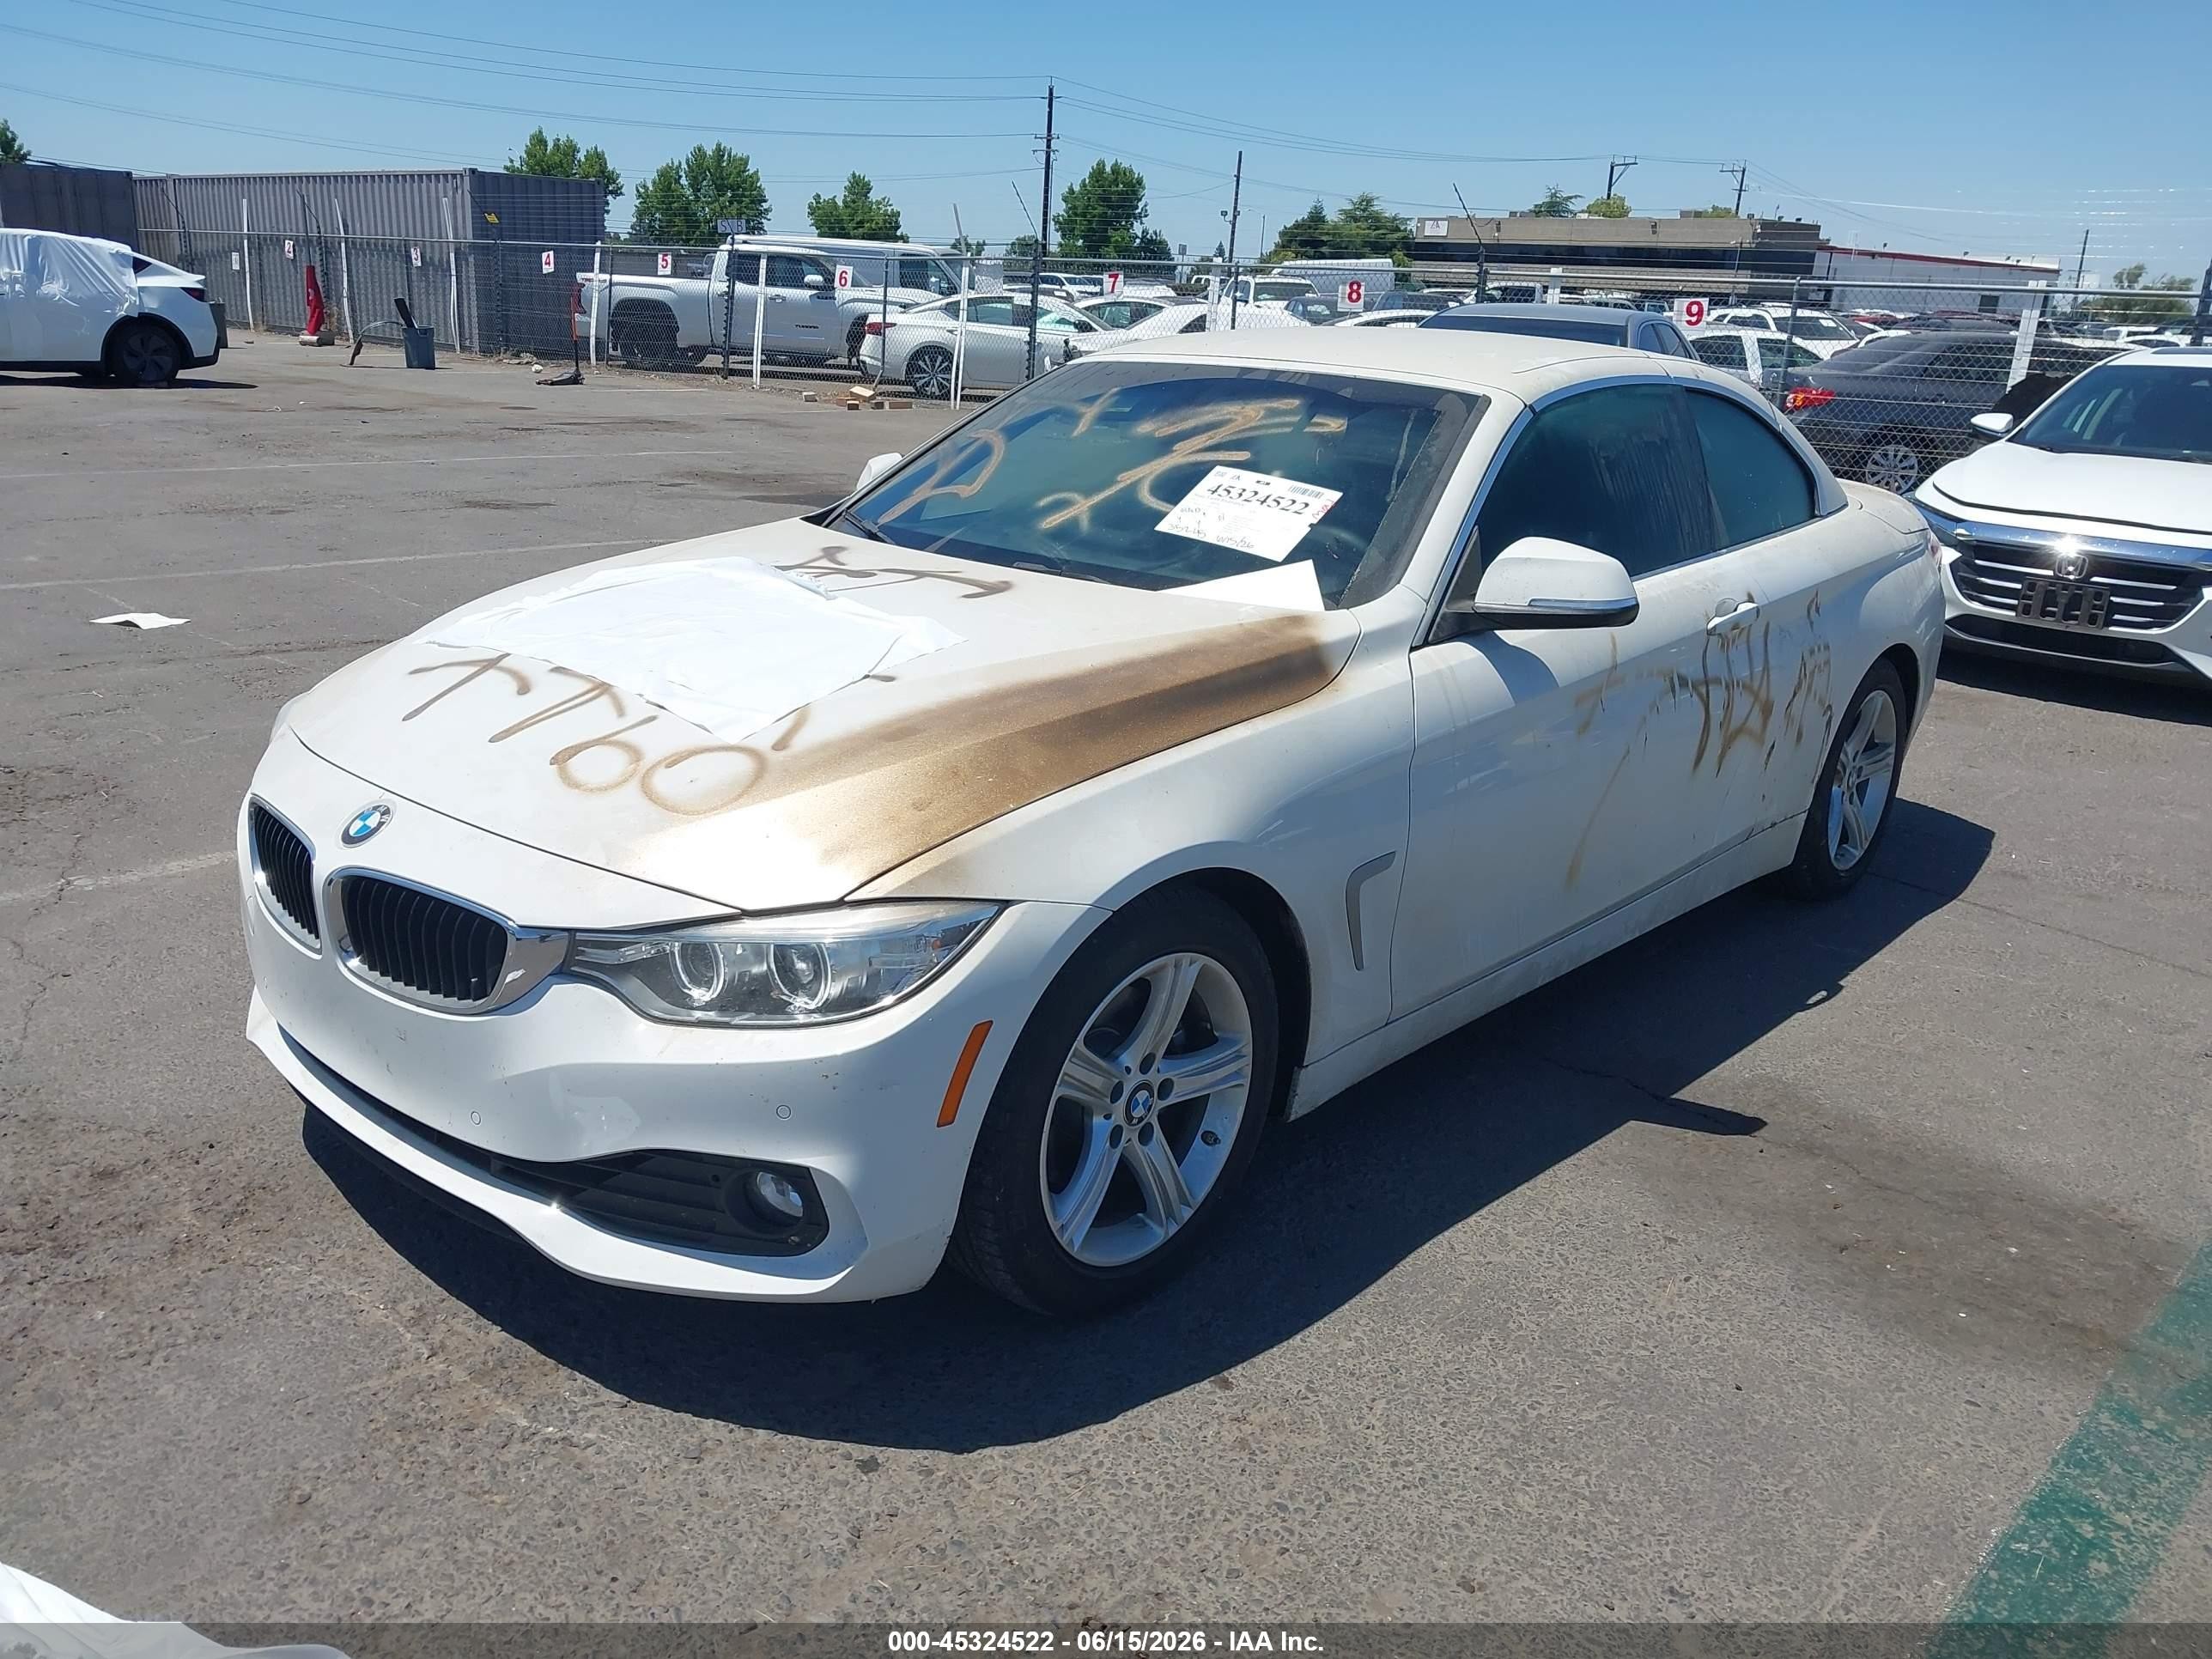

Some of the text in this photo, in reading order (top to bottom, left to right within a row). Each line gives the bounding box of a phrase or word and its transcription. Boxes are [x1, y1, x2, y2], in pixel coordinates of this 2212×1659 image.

[287, 241, 292, 254] 2
[413, 247, 419, 261] 3
[544, 252, 551, 267] 4
[661, 252, 669, 269] 5
[838, 270, 848, 288] 6
[1108, 273, 1120, 294] 7
[1347, 280, 1362, 303] 8
[1685, 301, 1705, 326] 9
[1206, 483, 1310, 515] 45324522
